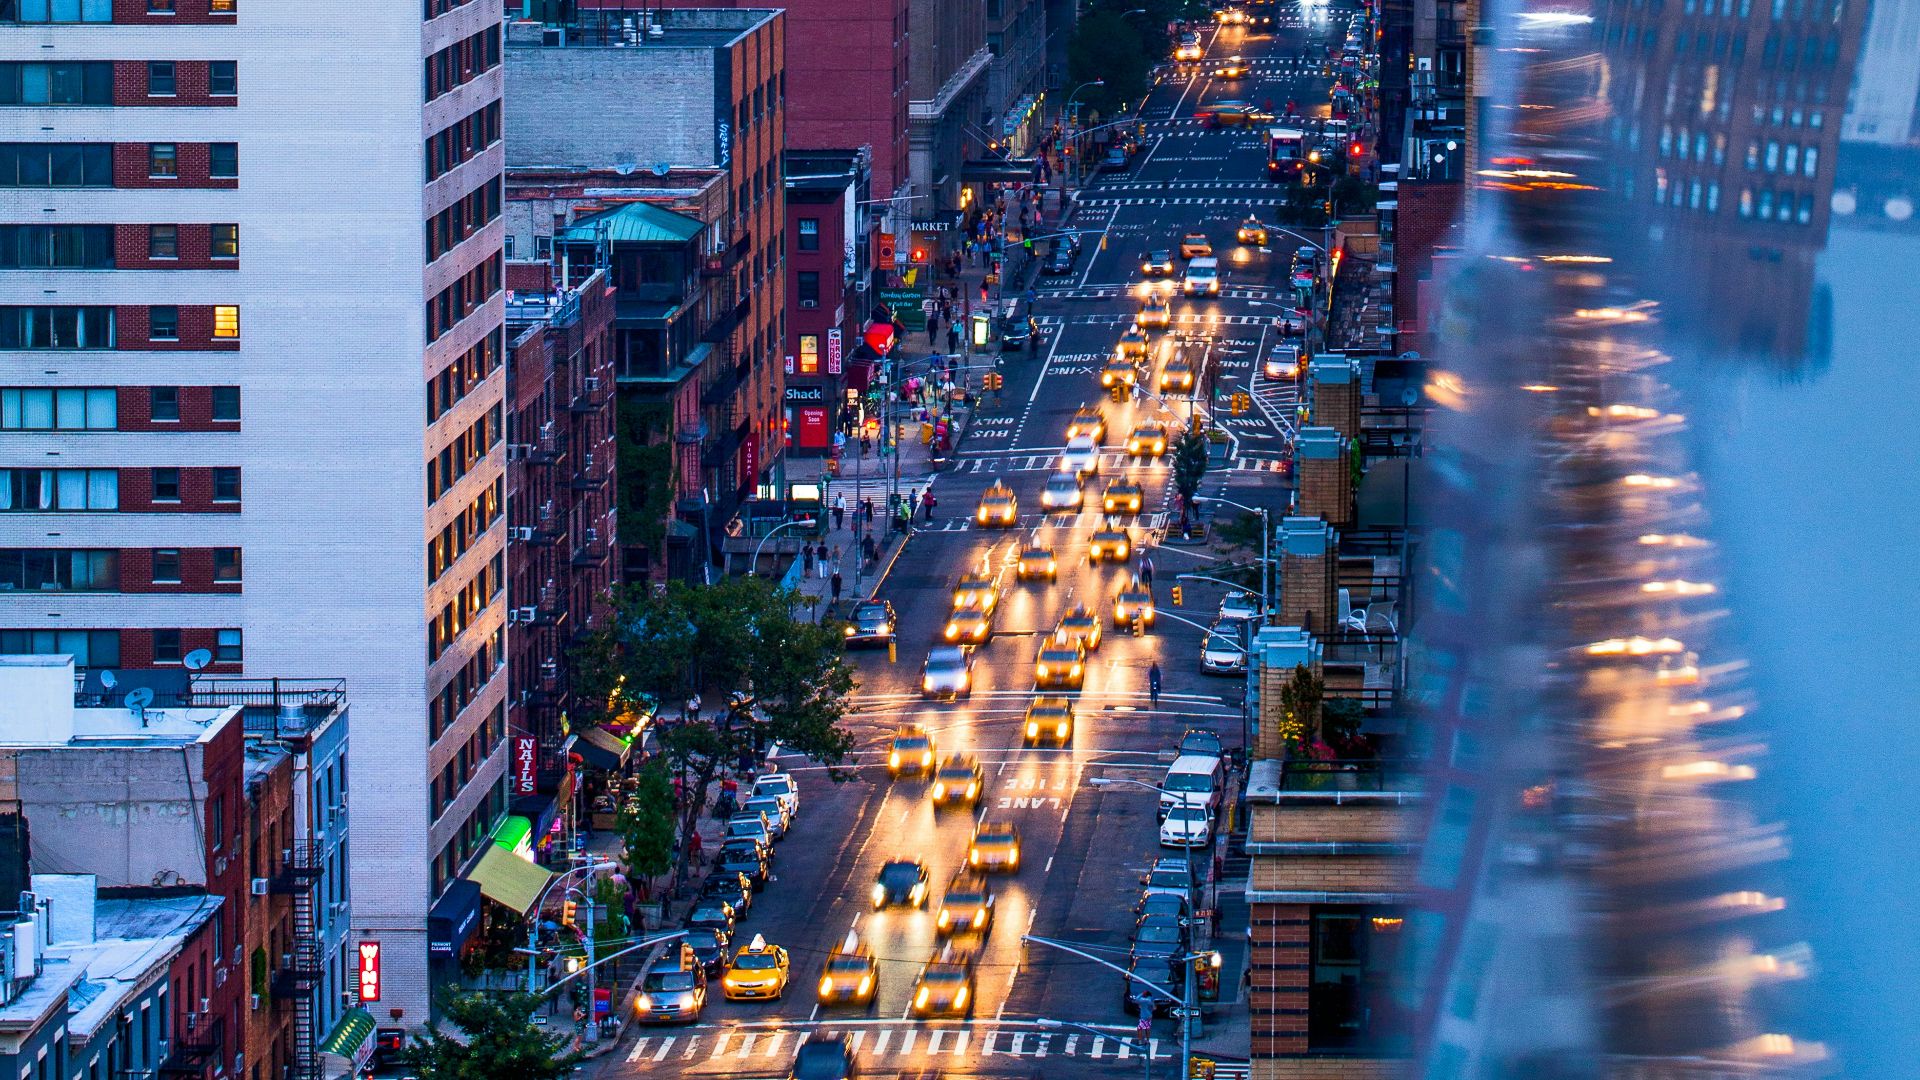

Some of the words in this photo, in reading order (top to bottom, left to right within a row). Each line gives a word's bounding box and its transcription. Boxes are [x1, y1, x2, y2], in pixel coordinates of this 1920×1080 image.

[1052, 353, 1099, 363] SCHOOL
[1047, 366, 1094, 375] X-ING
[786, 388, 821, 399] Shack
[973, 417, 1014, 426] ONLY
[1225, 419, 1267, 427] ONLY
[970, 430, 1009, 438] BUS
[519, 738, 535, 792] NAILS
[1004, 778, 1067, 790] FIRE
[997, 797, 1061, 810] LANE
[360, 944, 378, 998] WINE
